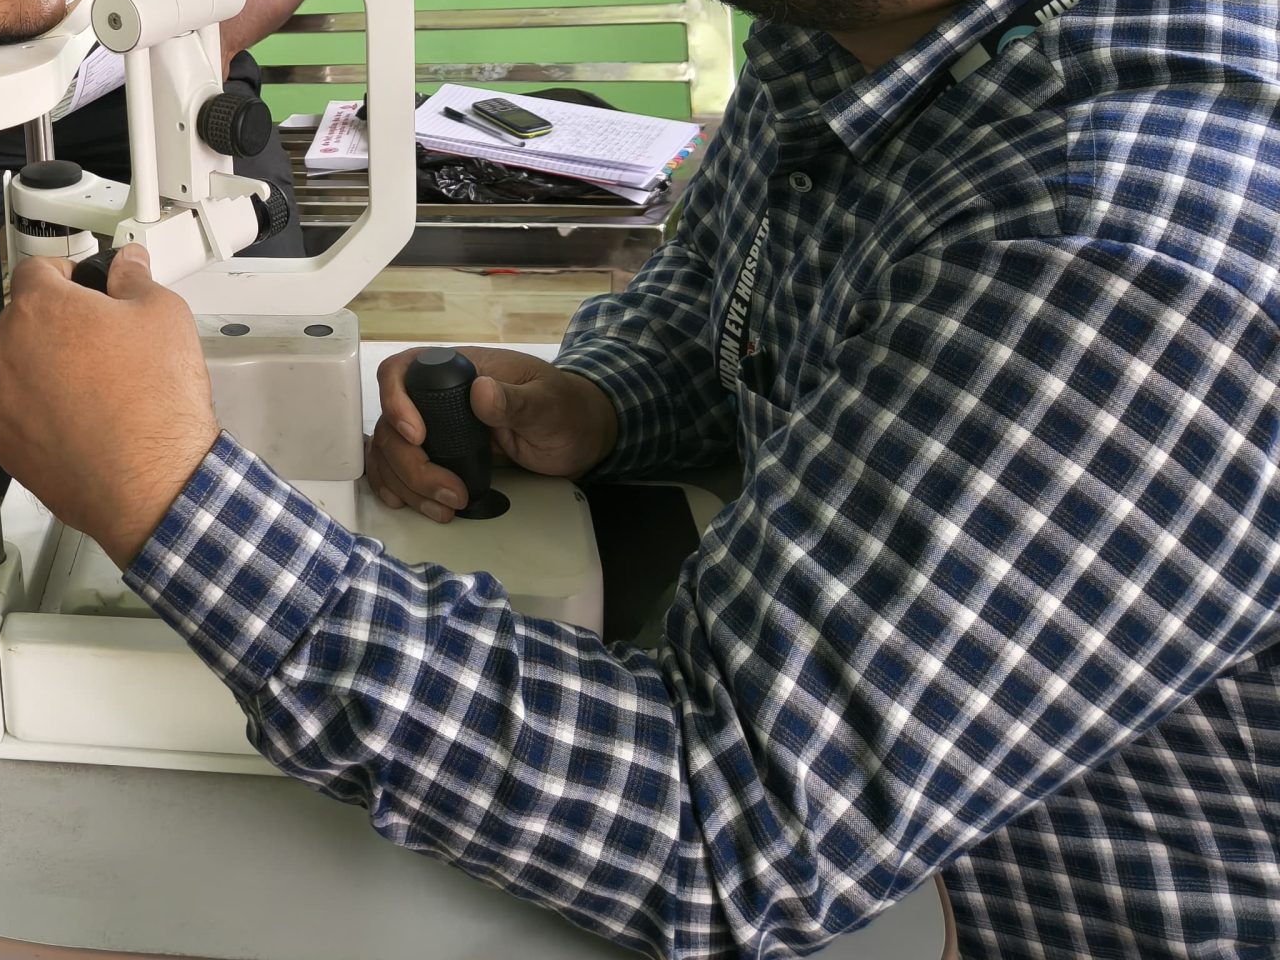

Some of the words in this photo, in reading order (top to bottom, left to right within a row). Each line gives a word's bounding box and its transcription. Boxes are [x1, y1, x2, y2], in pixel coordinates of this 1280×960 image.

[735, 208, 769, 302] HOSPITA
[725, 298, 747, 338] EYE
[720, 333, 740, 392] KIRAN
